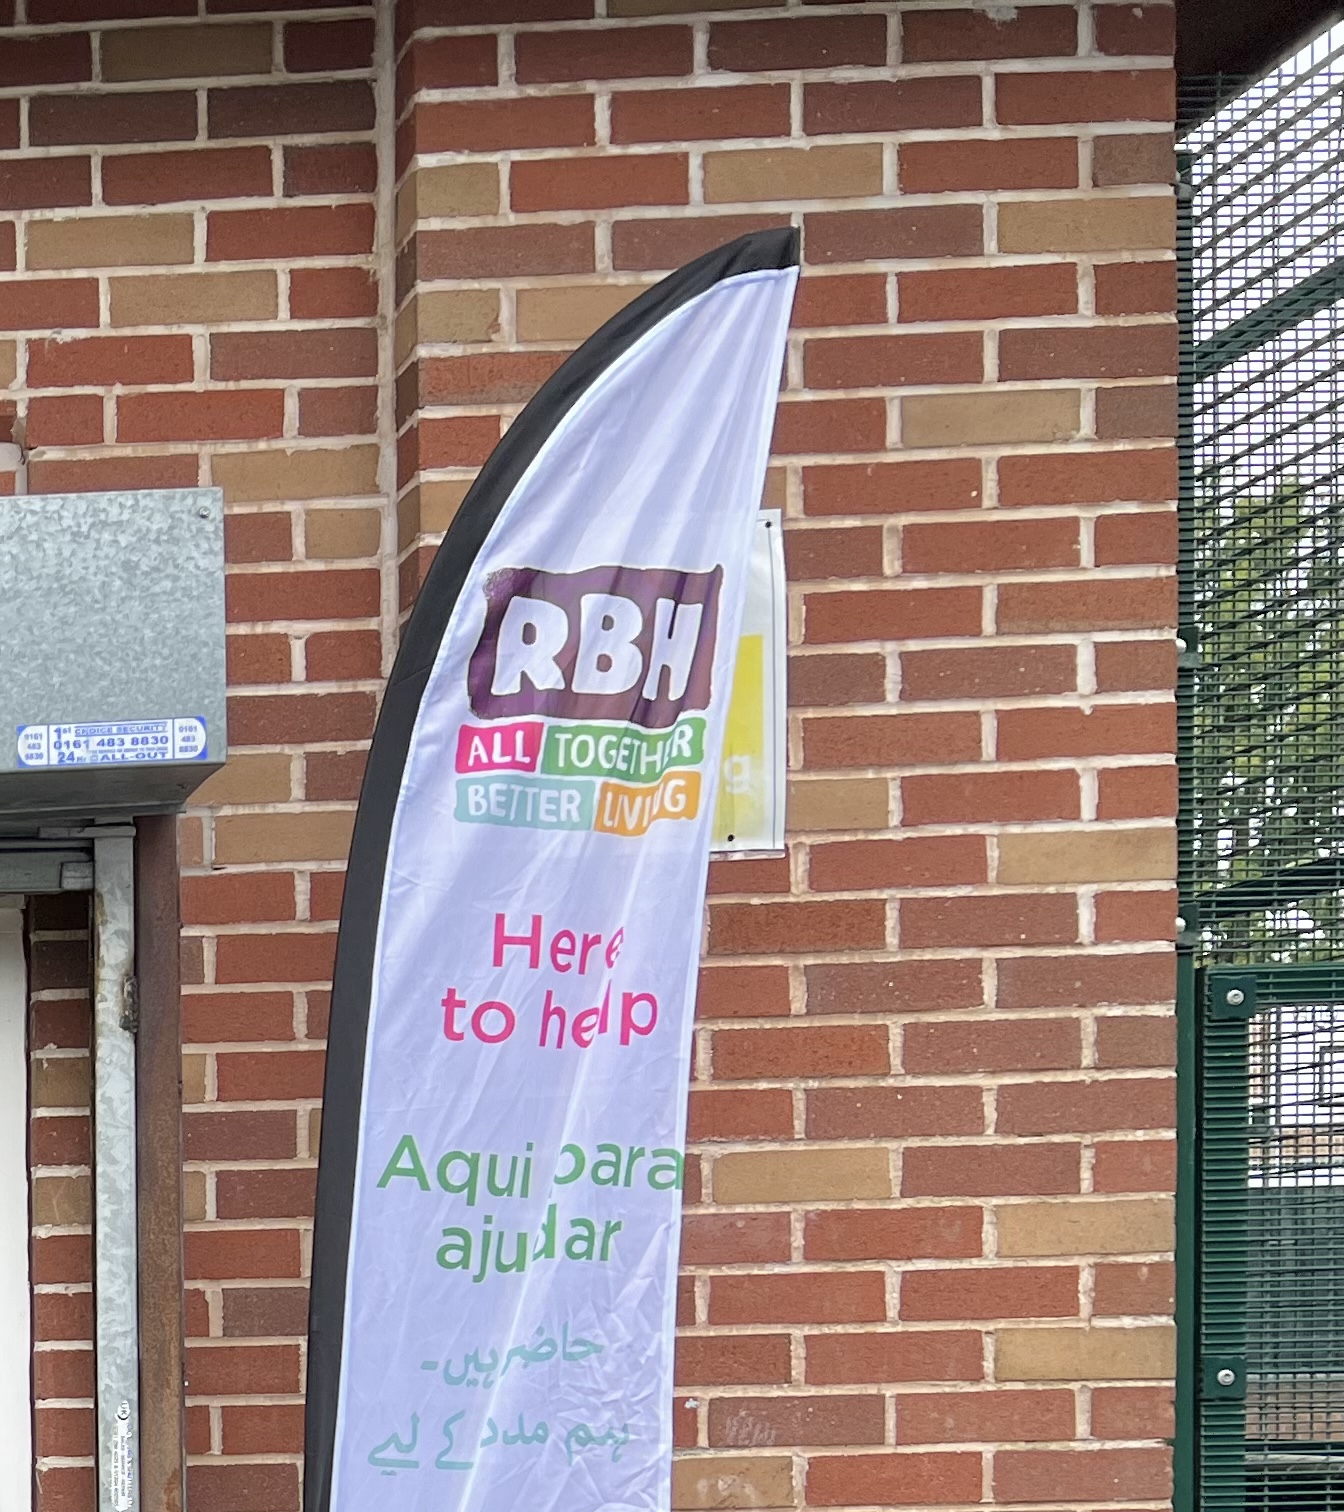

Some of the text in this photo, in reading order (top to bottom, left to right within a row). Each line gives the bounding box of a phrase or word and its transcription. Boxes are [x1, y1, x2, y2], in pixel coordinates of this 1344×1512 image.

[490, 593, 704, 701] RBH
[53, 739, 90, 750] 0161
[96, 738, 125, 747] 483
[130, 735, 169, 746] 8830
[57, 751, 75, 764] 24
[467, 731, 532, 767] ALL
[467, 785, 582, 823] BETTER
[441, 979, 658, 1049] to help
[376, 1134, 533, 1207] Aqui
[435, 1203, 622, 1284] ajudar
